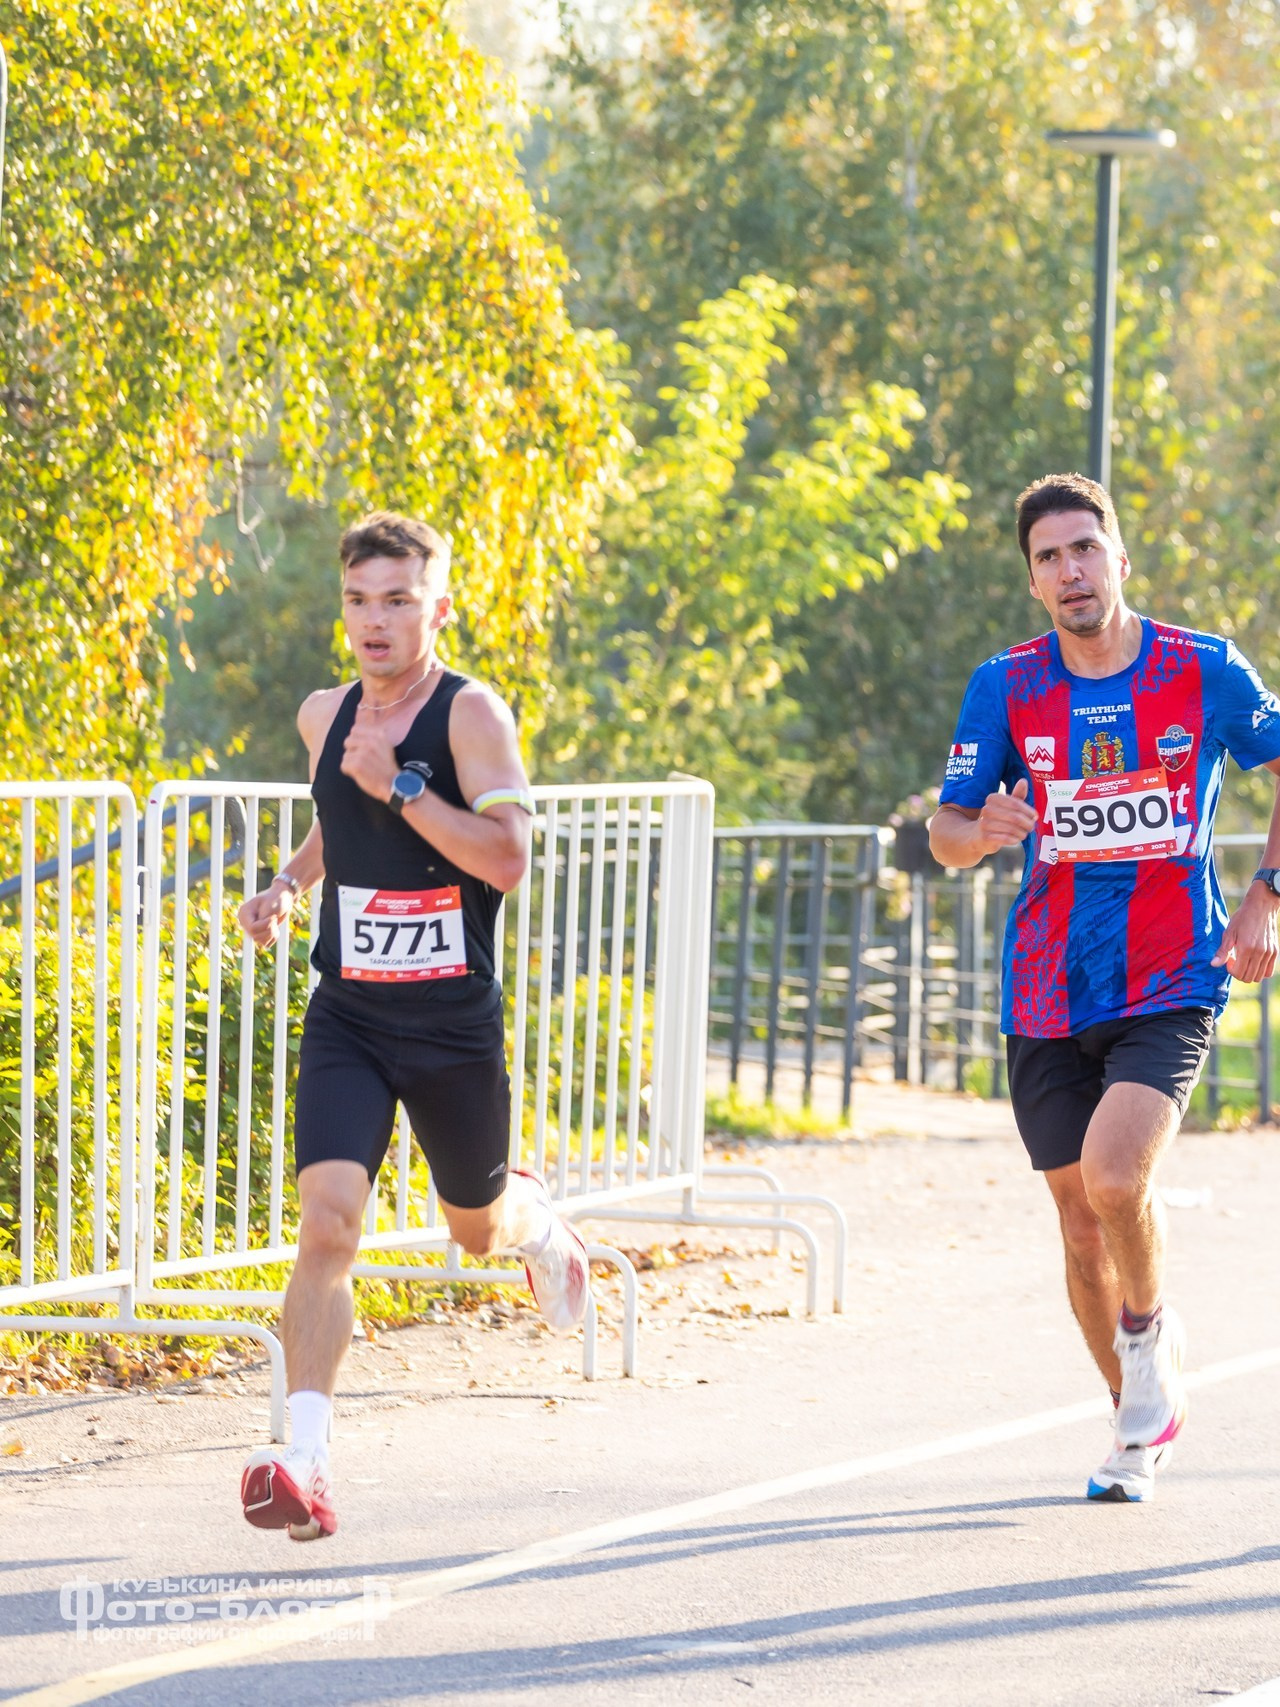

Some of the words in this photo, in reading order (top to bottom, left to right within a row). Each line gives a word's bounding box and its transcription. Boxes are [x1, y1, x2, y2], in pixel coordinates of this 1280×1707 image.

[1072, 703, 1132, 716] TRIATHLON
[1087, 714, 1118, 725] TEAM
[1158, 743, 1192, 757] ЕНИСЕЙ
[1055, 795, 1168, 838] 5900
[354, 918, 450, 956] 5771
[370, 958, 403, 966] ТАРАСОВ
